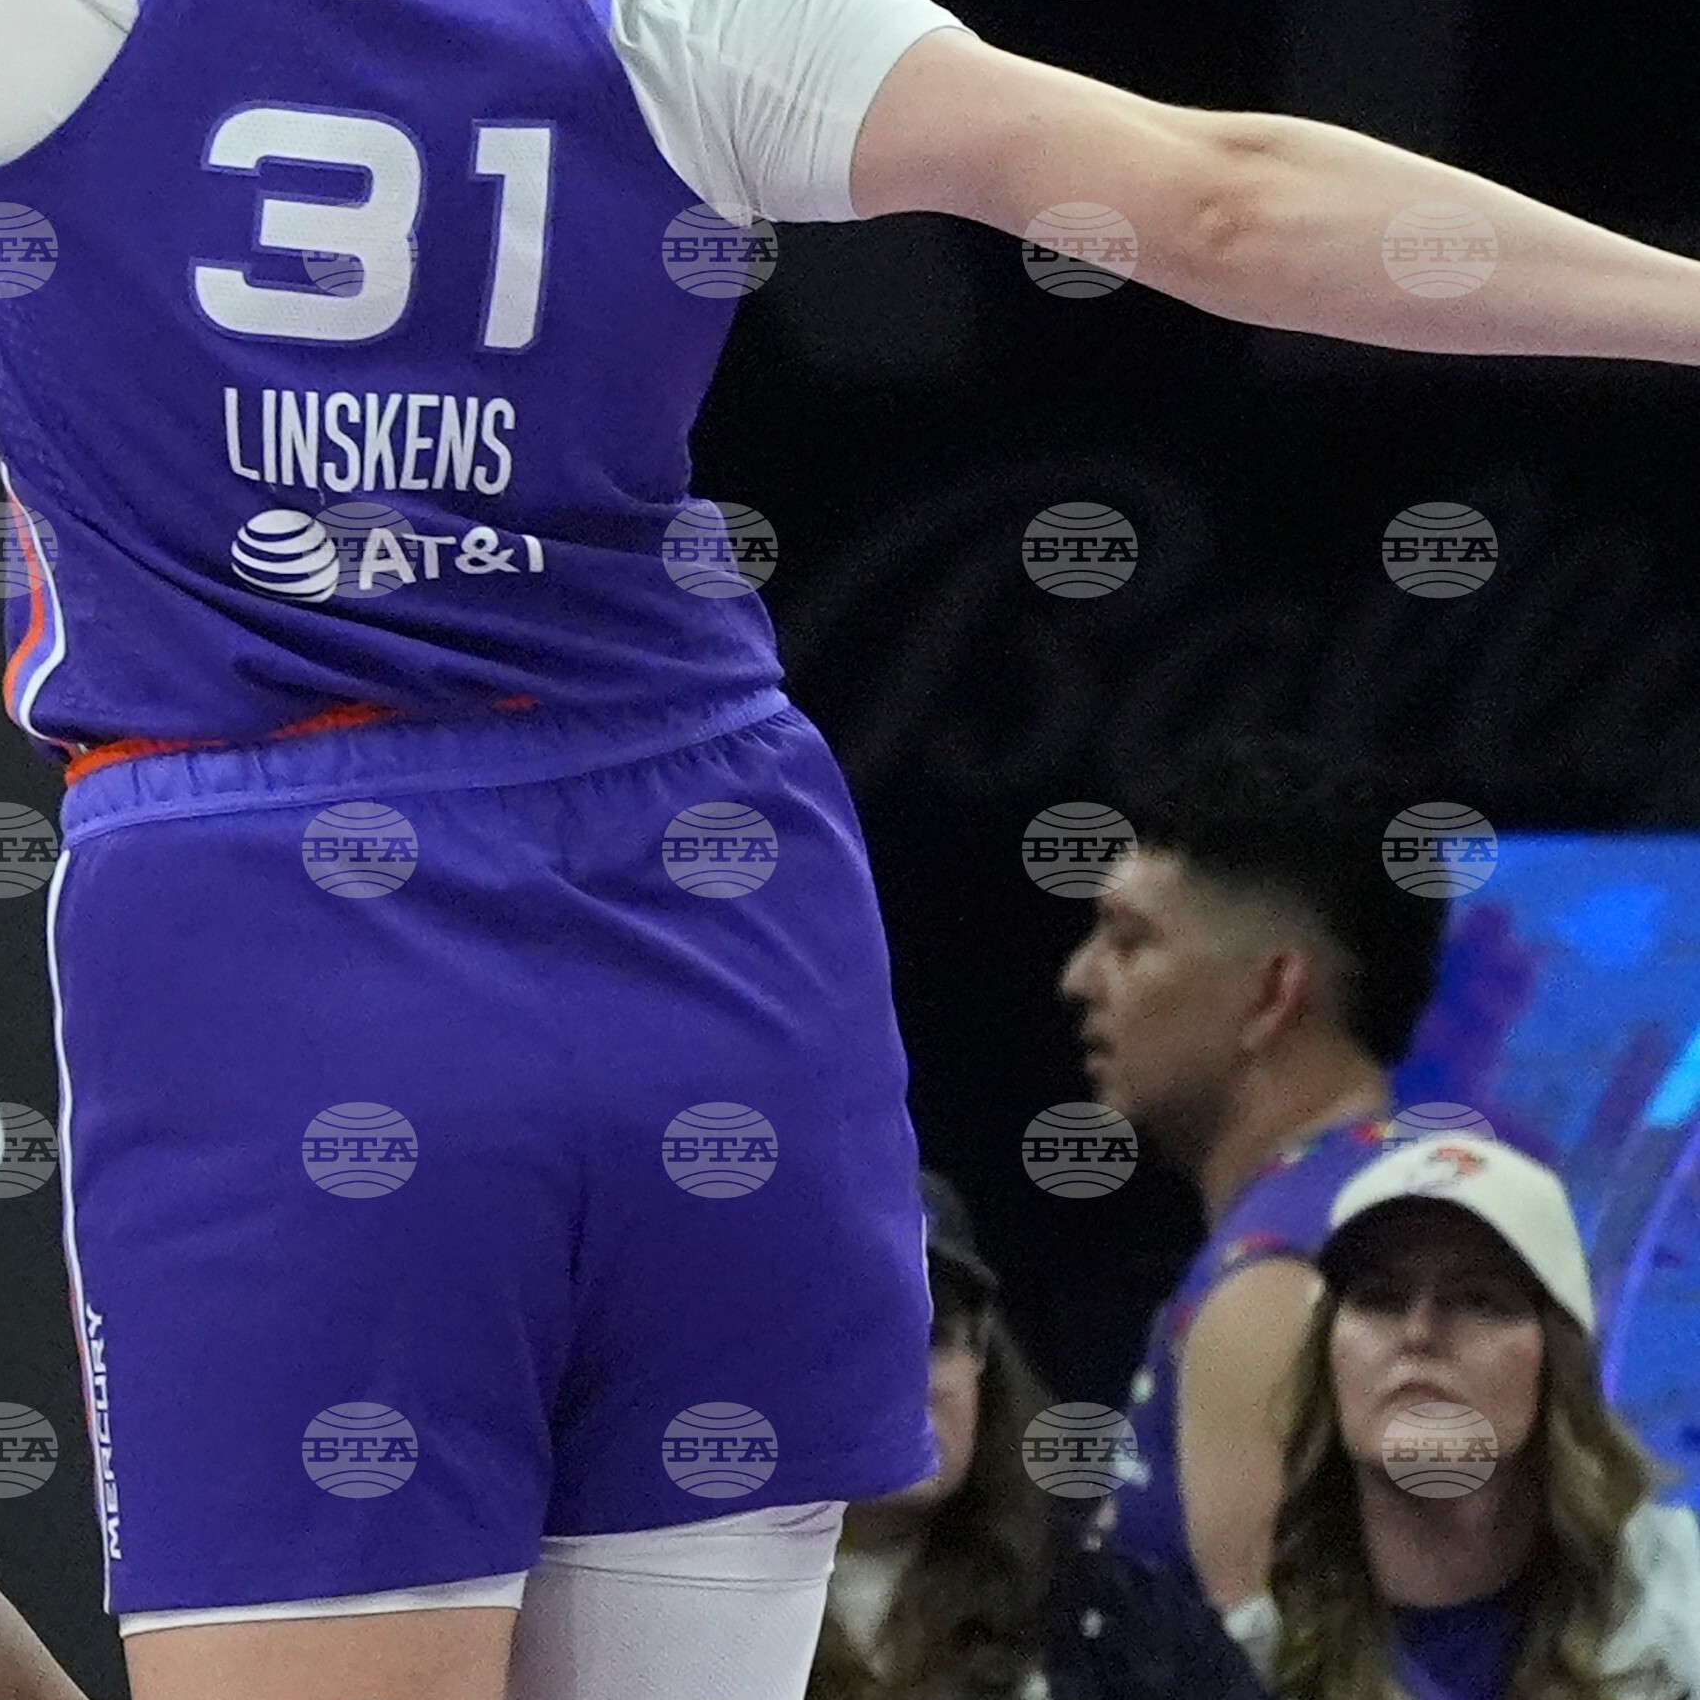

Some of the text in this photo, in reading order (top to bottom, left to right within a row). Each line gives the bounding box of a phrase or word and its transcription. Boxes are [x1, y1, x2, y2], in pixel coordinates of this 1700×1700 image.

[189, 101, 556, 353] 31
[223, 387, 516, 495] LINSKENS
[86, 1302, 123, 1561] MERCURY
